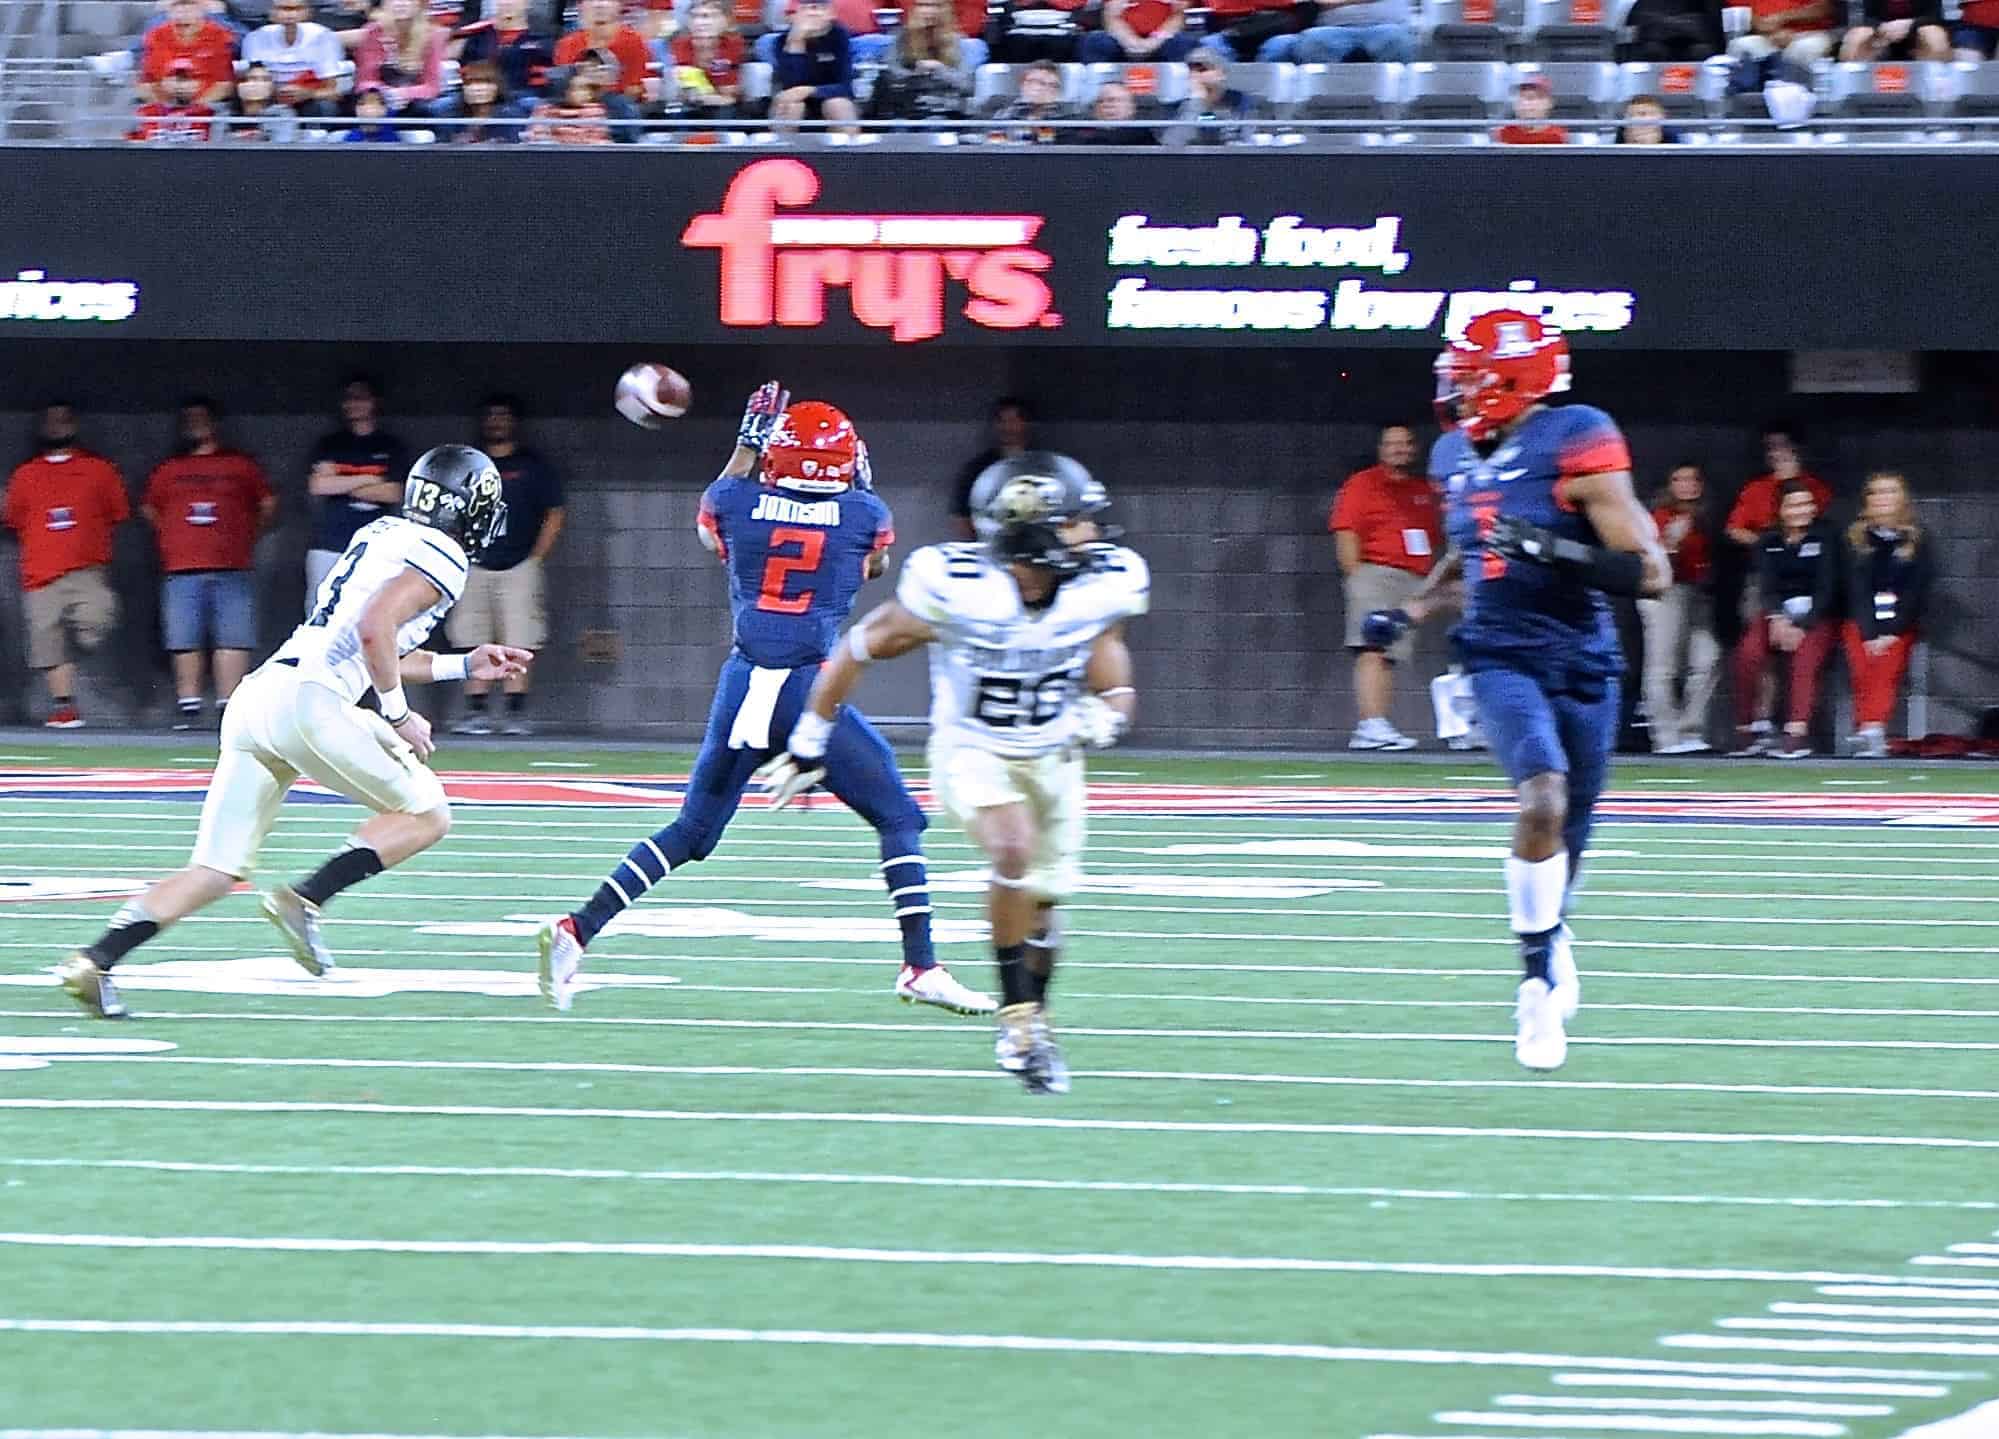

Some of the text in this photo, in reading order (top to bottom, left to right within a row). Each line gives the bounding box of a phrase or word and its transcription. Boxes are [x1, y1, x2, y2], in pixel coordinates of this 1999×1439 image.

[1108, 214, 1409, 275] fresh food,
[1108, 277, 1329, 330] famous
[1330, 278, 1447, 331] low
[411, 478, 440, 513] 13
[756, 528, 827, 615] 2
